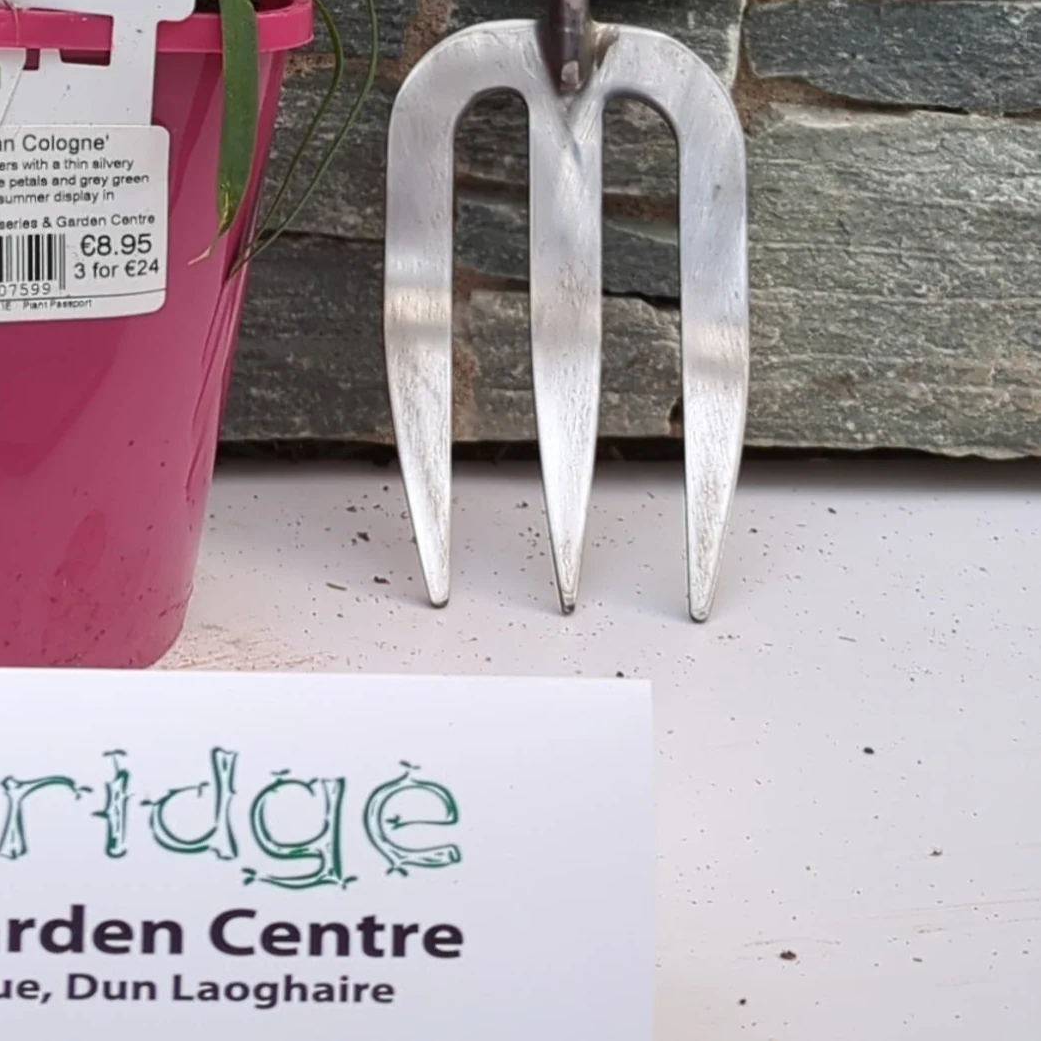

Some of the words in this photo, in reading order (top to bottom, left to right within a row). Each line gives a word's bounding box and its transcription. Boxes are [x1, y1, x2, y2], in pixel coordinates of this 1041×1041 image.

[22, 134, 110, 155] Cologne'
[22, 159, 49, 171] with
[52, 161, 61, 170] a
[64, 158, 88, 170] thin
[92, 158, 134, 172] silvery
[9, 175, 48, 190] petals
[51, 174, 76, 186] and
[80, 175, 108, 188] grey
[112, 173, 149, 186] green
[53, 191, 99, 205] display
[103, 190, 114, 200] in
[42, 217, 52, 229] &
[56, 216, 107, 229] Garden
[110, 214, 156, 226] Centre
[80, 233, 152, 257] €8.95
[74, 263, 85, 279] 3
[93, 261, 119, 278] for
[125, 258, 160, 277] €24
[209, 908, 464, 959] Centre
[66, 973, 157, 1001] Dun
[173, 973, 395, 1010] Laoghaire
